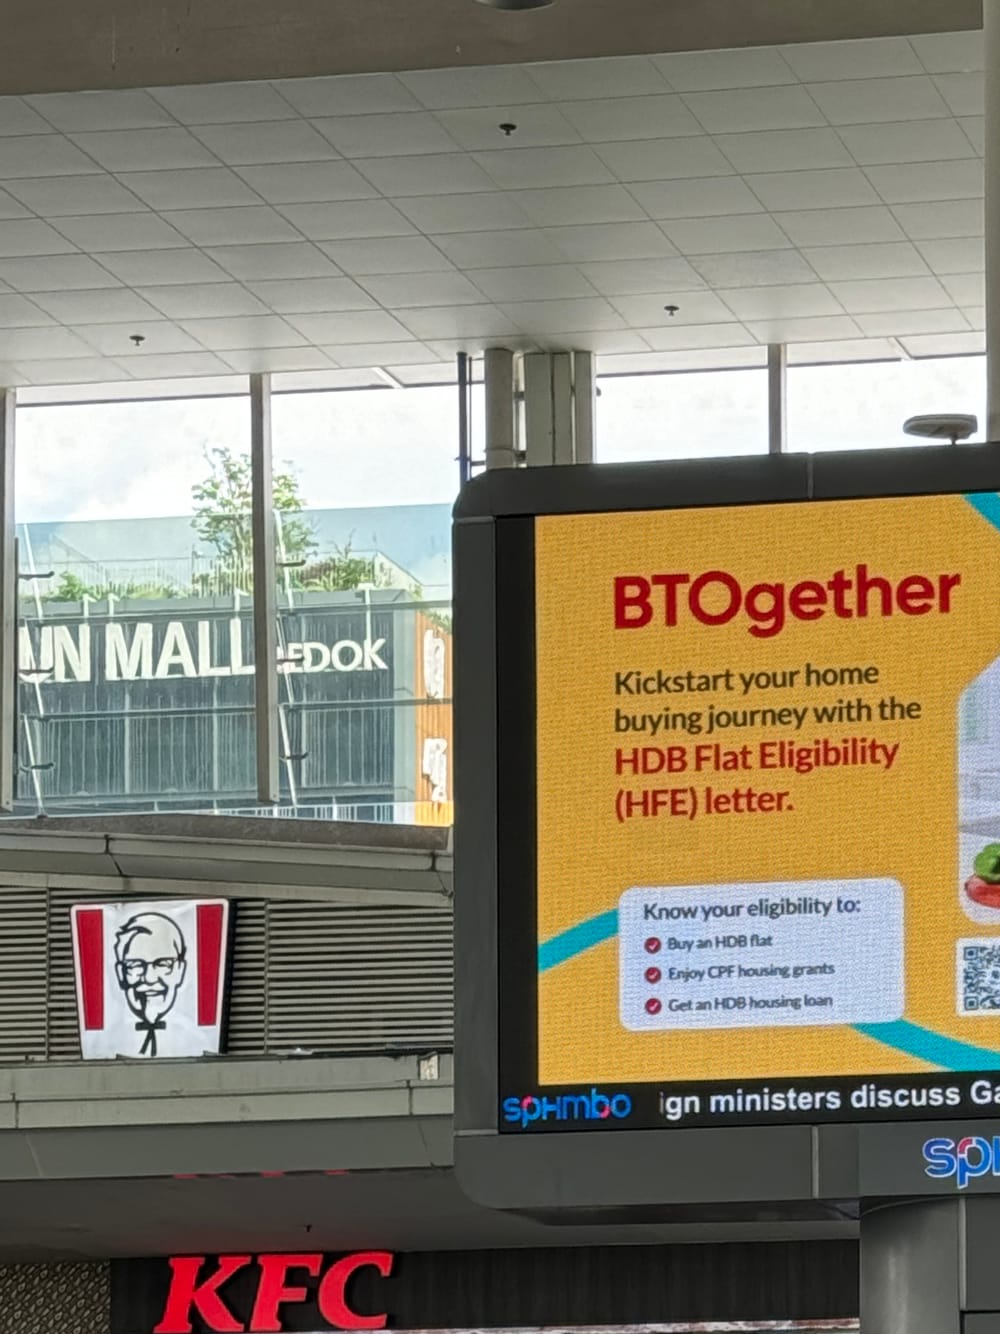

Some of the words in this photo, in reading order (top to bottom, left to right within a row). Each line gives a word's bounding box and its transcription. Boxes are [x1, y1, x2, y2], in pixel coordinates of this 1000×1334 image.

[613, 564, 961, 638] BTOgether
[105, 618, 256, 681] MALL
[277, 638, 388, 673] EDOK
[615, 669, 734, 695] Kickstart
[740, 670, 800, 694] your
[805, 663, 879, 687] home
[614, 707, 702, 736] buying
[707, 704, 807, 734] journey
[813, 699, 872, 723] with
[879, 697, 922, 720] the
[615, 745, 688, 775] HDB
[694, 743, 753, 772] Flat
[759, 736, 900, 773] Eligibility
[615, 786, 697, 822] (HFE)
[705, 787, 794, 815] letter.
[643, 903, 698, 920] Know
[701, 904, 744, 922] your
[747, 897, 832, 919] eligibility
[836, 896, 861, 914] to:
[667, 937, 693, 952] Buy
[696, 938, 712, 949] an
[715, 936, 747, 948] HDB
[750, 934, 773, 947] flat
[668, 967, 704, 982] Enjoy
[708, 965, 734, 979] CPF
[738, 963, 790, 978] housing
[793, 962, 835, 977] grants
[668, 998, 693, 1012] Get
[695, 1000, 712, 1011] an
[715, 997, 746, 1010] HDB
[750, 995, 800, 1010] housing
[804, 994, 833, 1007] loan
[710, 1086, 840, 1114] ministers
[850, 1081, 961, 1108] discuss
[153, 1251, 393, 1334] KFC
